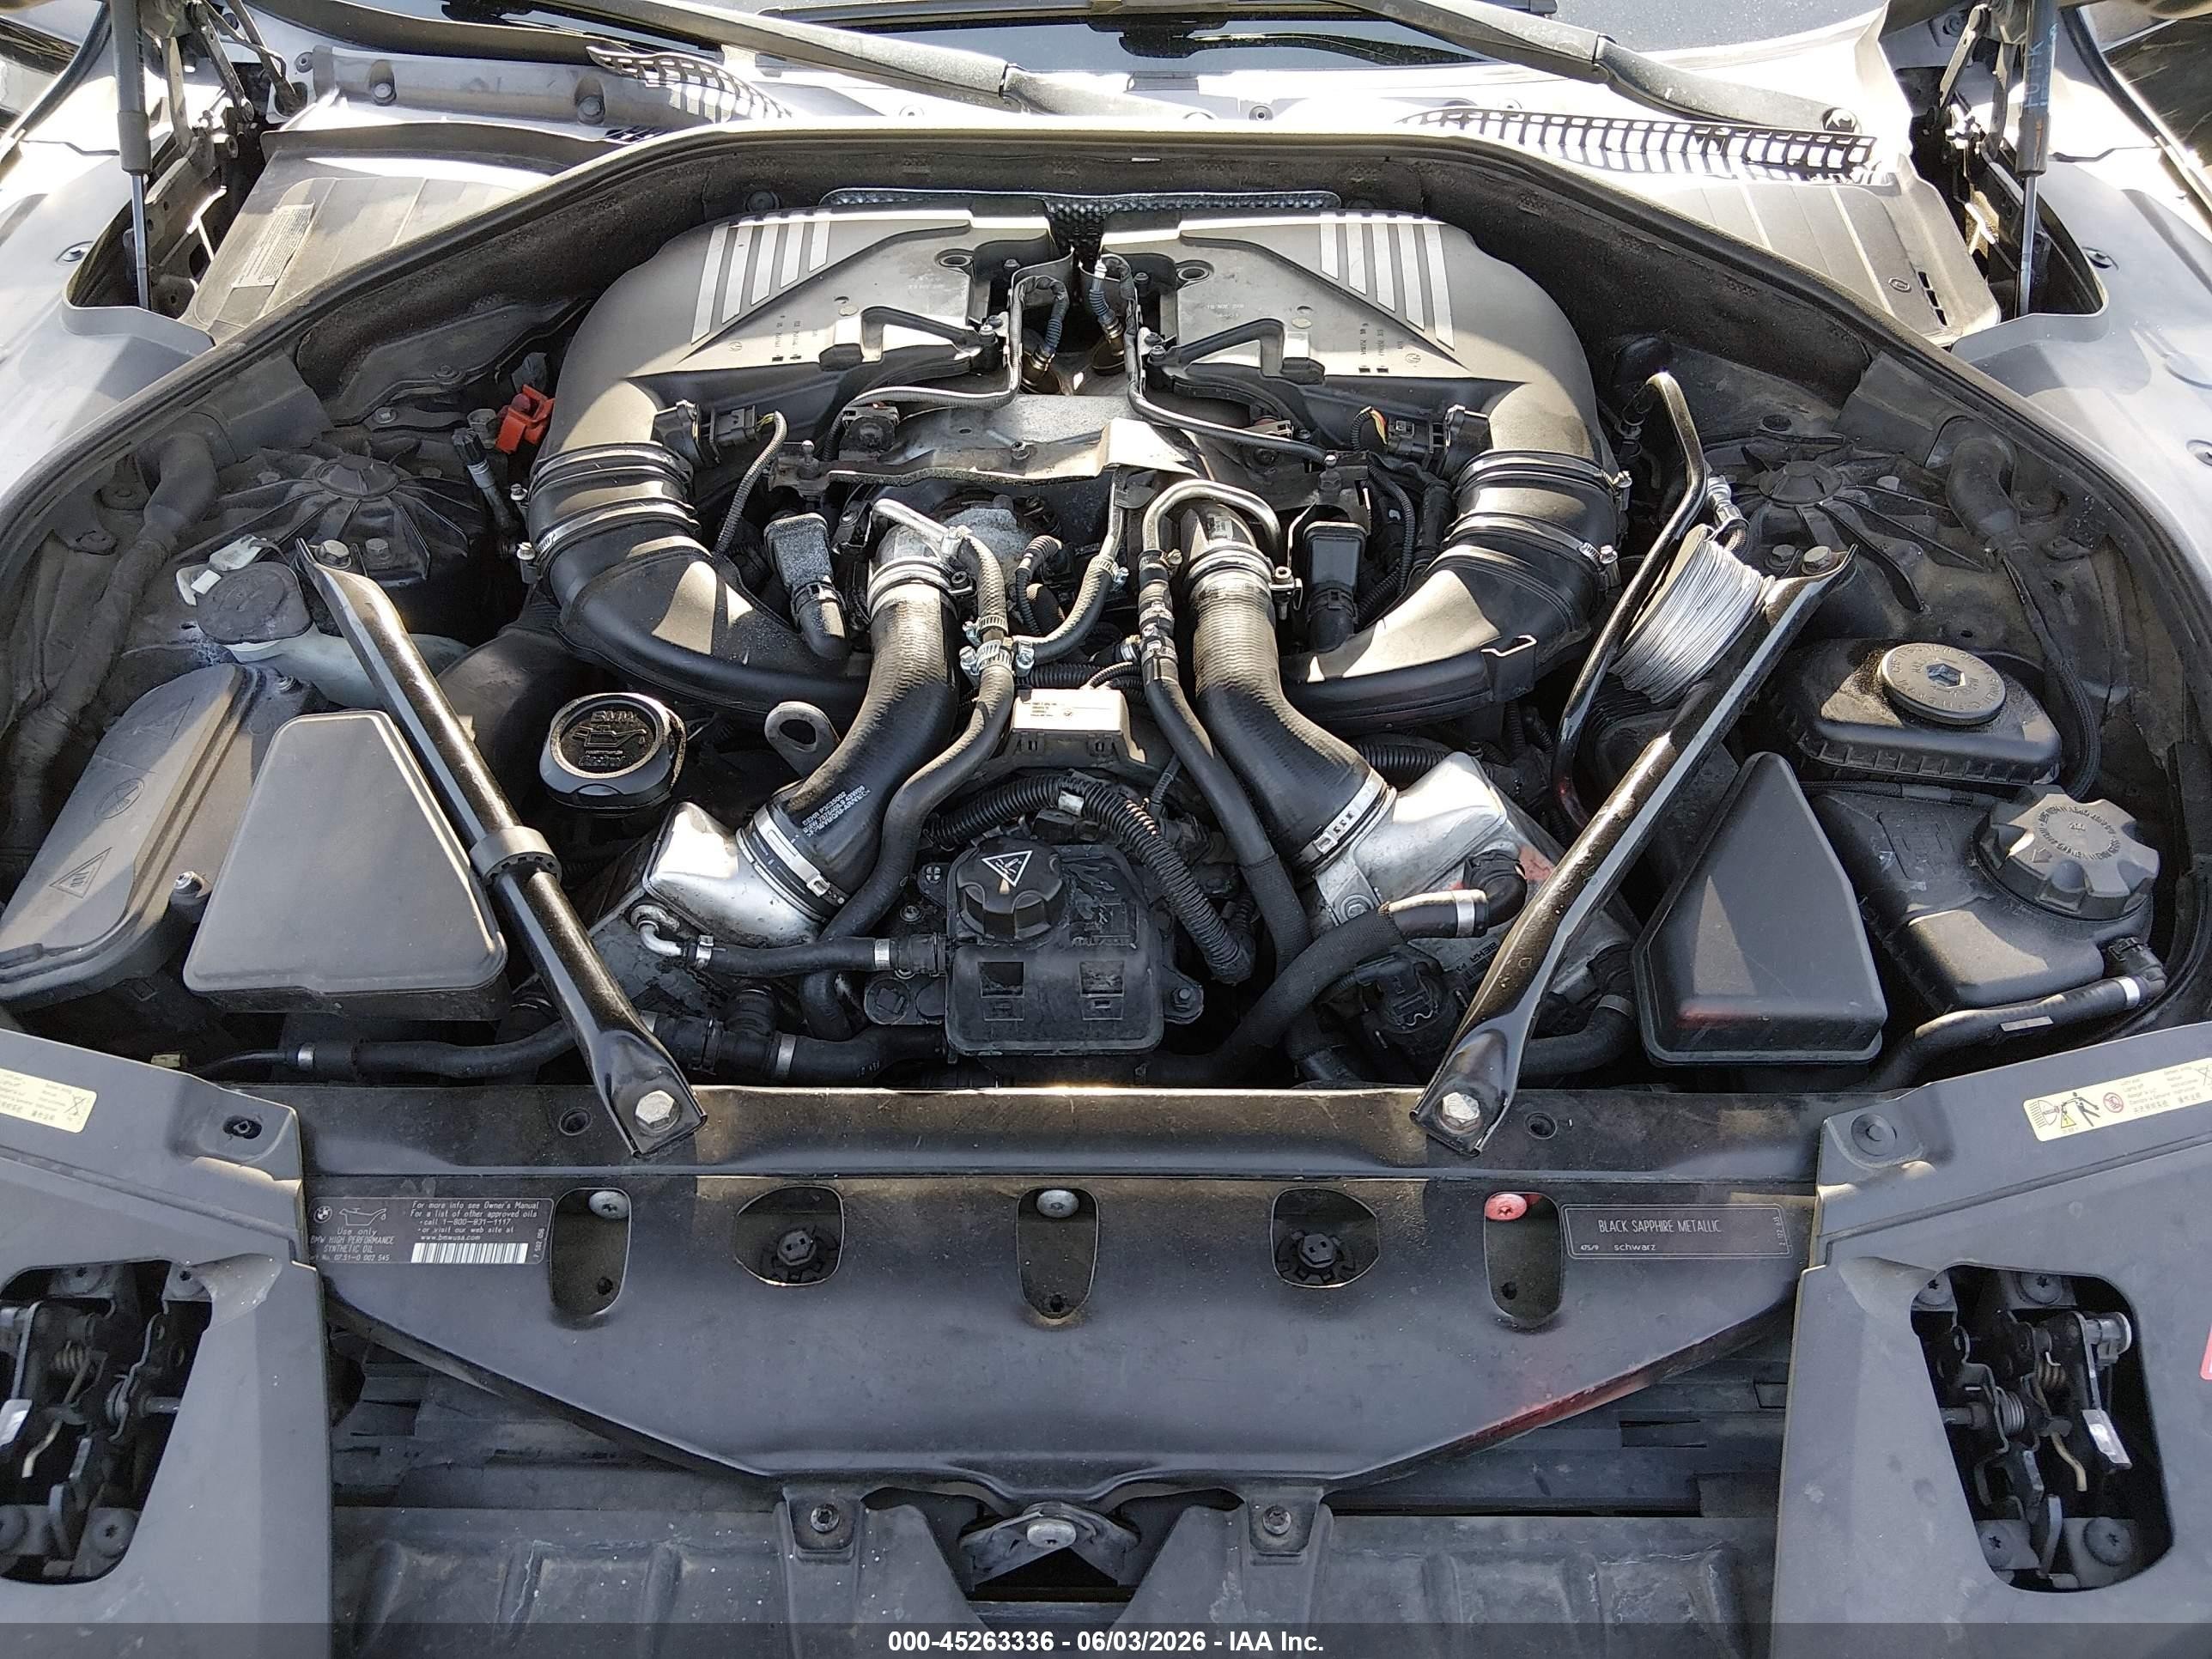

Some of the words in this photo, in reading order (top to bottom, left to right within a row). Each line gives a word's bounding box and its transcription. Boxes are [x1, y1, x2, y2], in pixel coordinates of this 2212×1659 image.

[1470, 941, 1498, 963] BEHR
[412, 1200, 424, 1209] For
[483, 1200, 511, 1209] Owner's
[515, 1200, 539, 1209] Manual
[410, 1208, 422, 1217] For
[435, 1209, 448, 1218] list
[452, 1209, 461, 1218] of
[464, 1209, 483, 1218] other
[487, 1209, 520, 1218] approved
[522, 1209, 538, 1218] oils
[1598, 1219, 1629, 1233] BLACK
[1632, 1219, 1674, 1233] SAPPHIRE
[1677, 1219, 1723, 1233] METALLIC
[357, 1227, 378, 1237] only
[1613, 1243, 1656, 1251] schwarz
